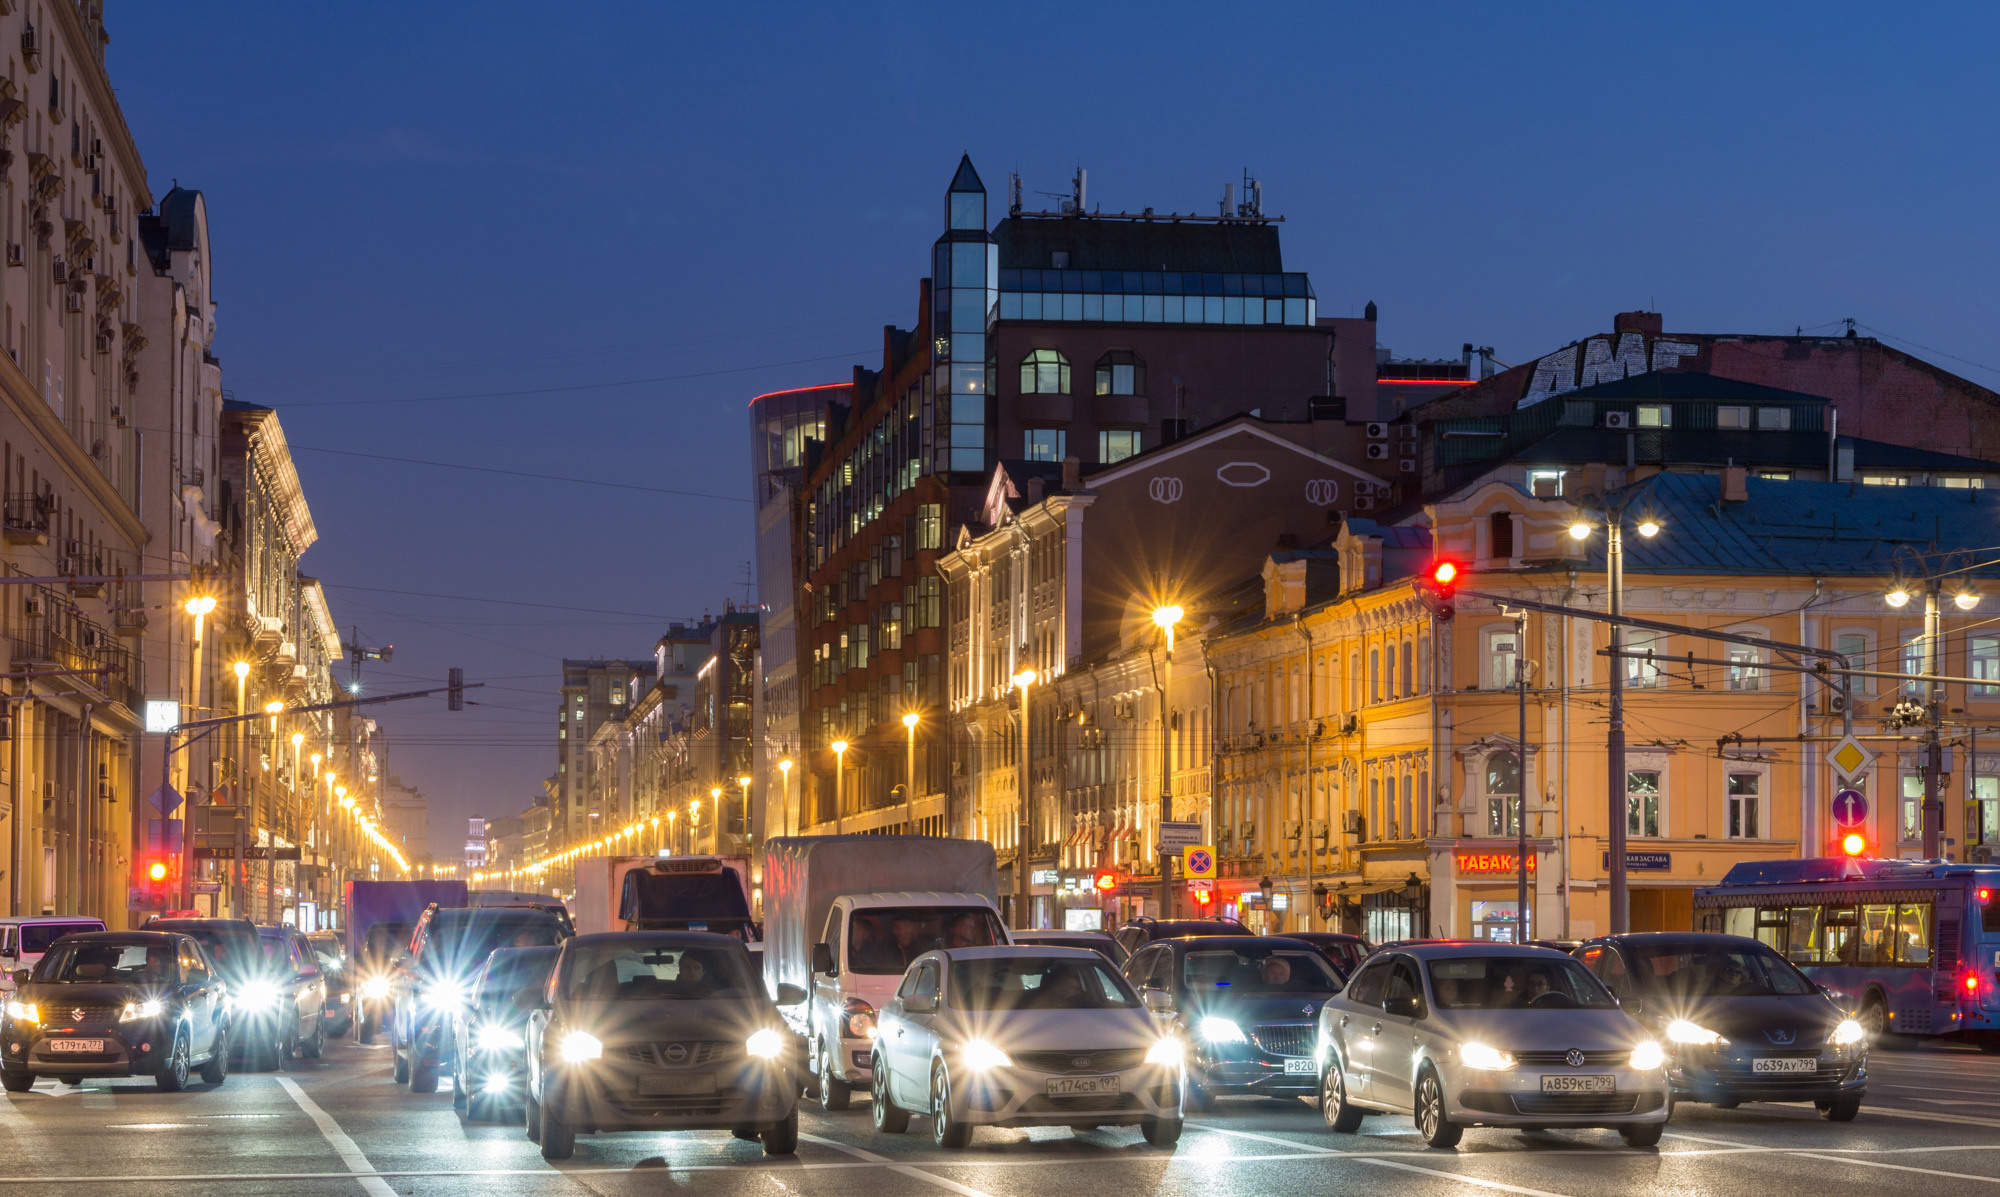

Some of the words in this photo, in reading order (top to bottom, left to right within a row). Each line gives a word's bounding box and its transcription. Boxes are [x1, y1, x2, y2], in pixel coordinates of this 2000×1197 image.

[211, 848, 278, 857] ТВЕСКА
[1457, 854, 1512, 872] ТАБАК
[53, 1041, 87, 1050] С179ТА
[88, 1040, 102, 1048] 777
[1756, 1060, 1797, 1071] О639АУ
[1798, 1059, 1814, 1068] 799
[1050, 1079, 1097, 1093] Н174СВ
[1099, 1077, 1116, 1088] 197
[1546, 1077, 1592, 1090] А859КЕ
[1594, 1076, 1612, 1087] 799
